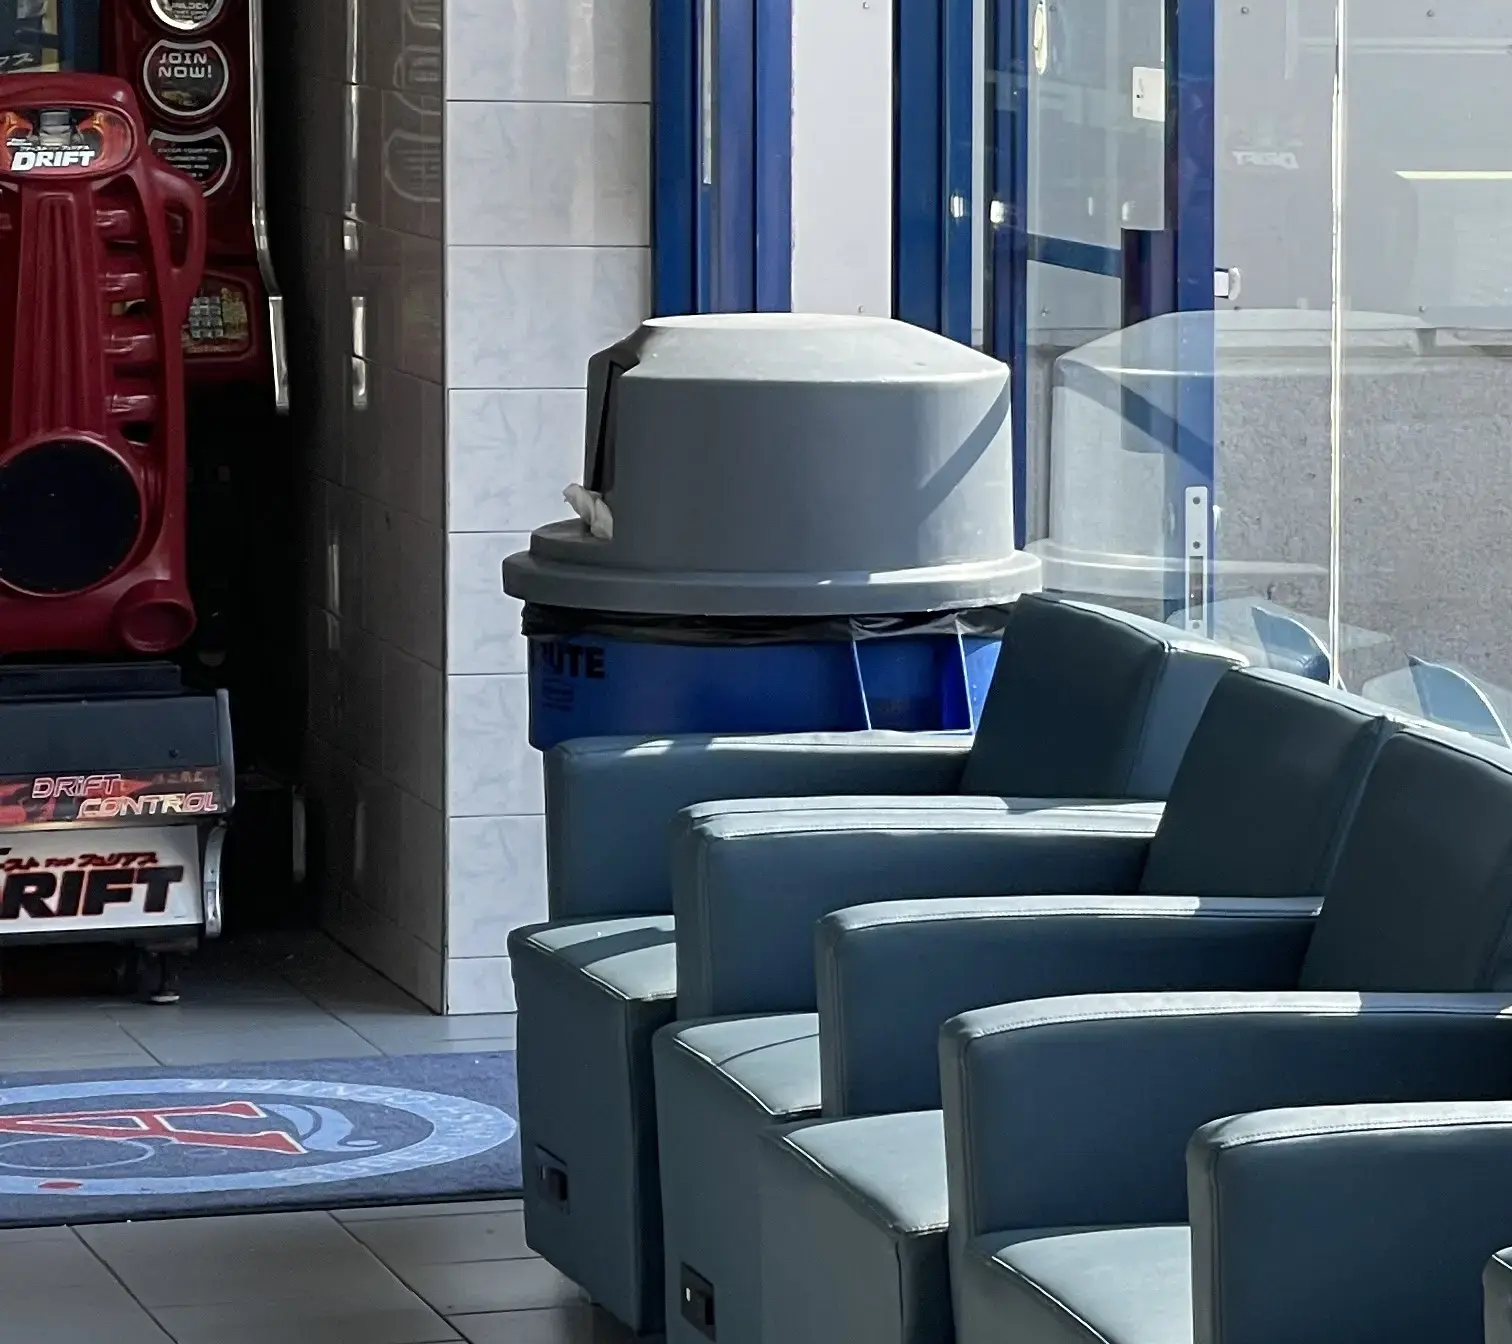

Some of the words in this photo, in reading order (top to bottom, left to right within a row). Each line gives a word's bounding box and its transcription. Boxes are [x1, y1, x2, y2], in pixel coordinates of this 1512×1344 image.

[158, 52, 208, 65] JOIN
[157, 65, 213, 79] NOW!
[11, 150, 96, 171] DRIFT
[76, 791, 219, 820] CONTROL
[0, 865, 185, 921] RIFT
